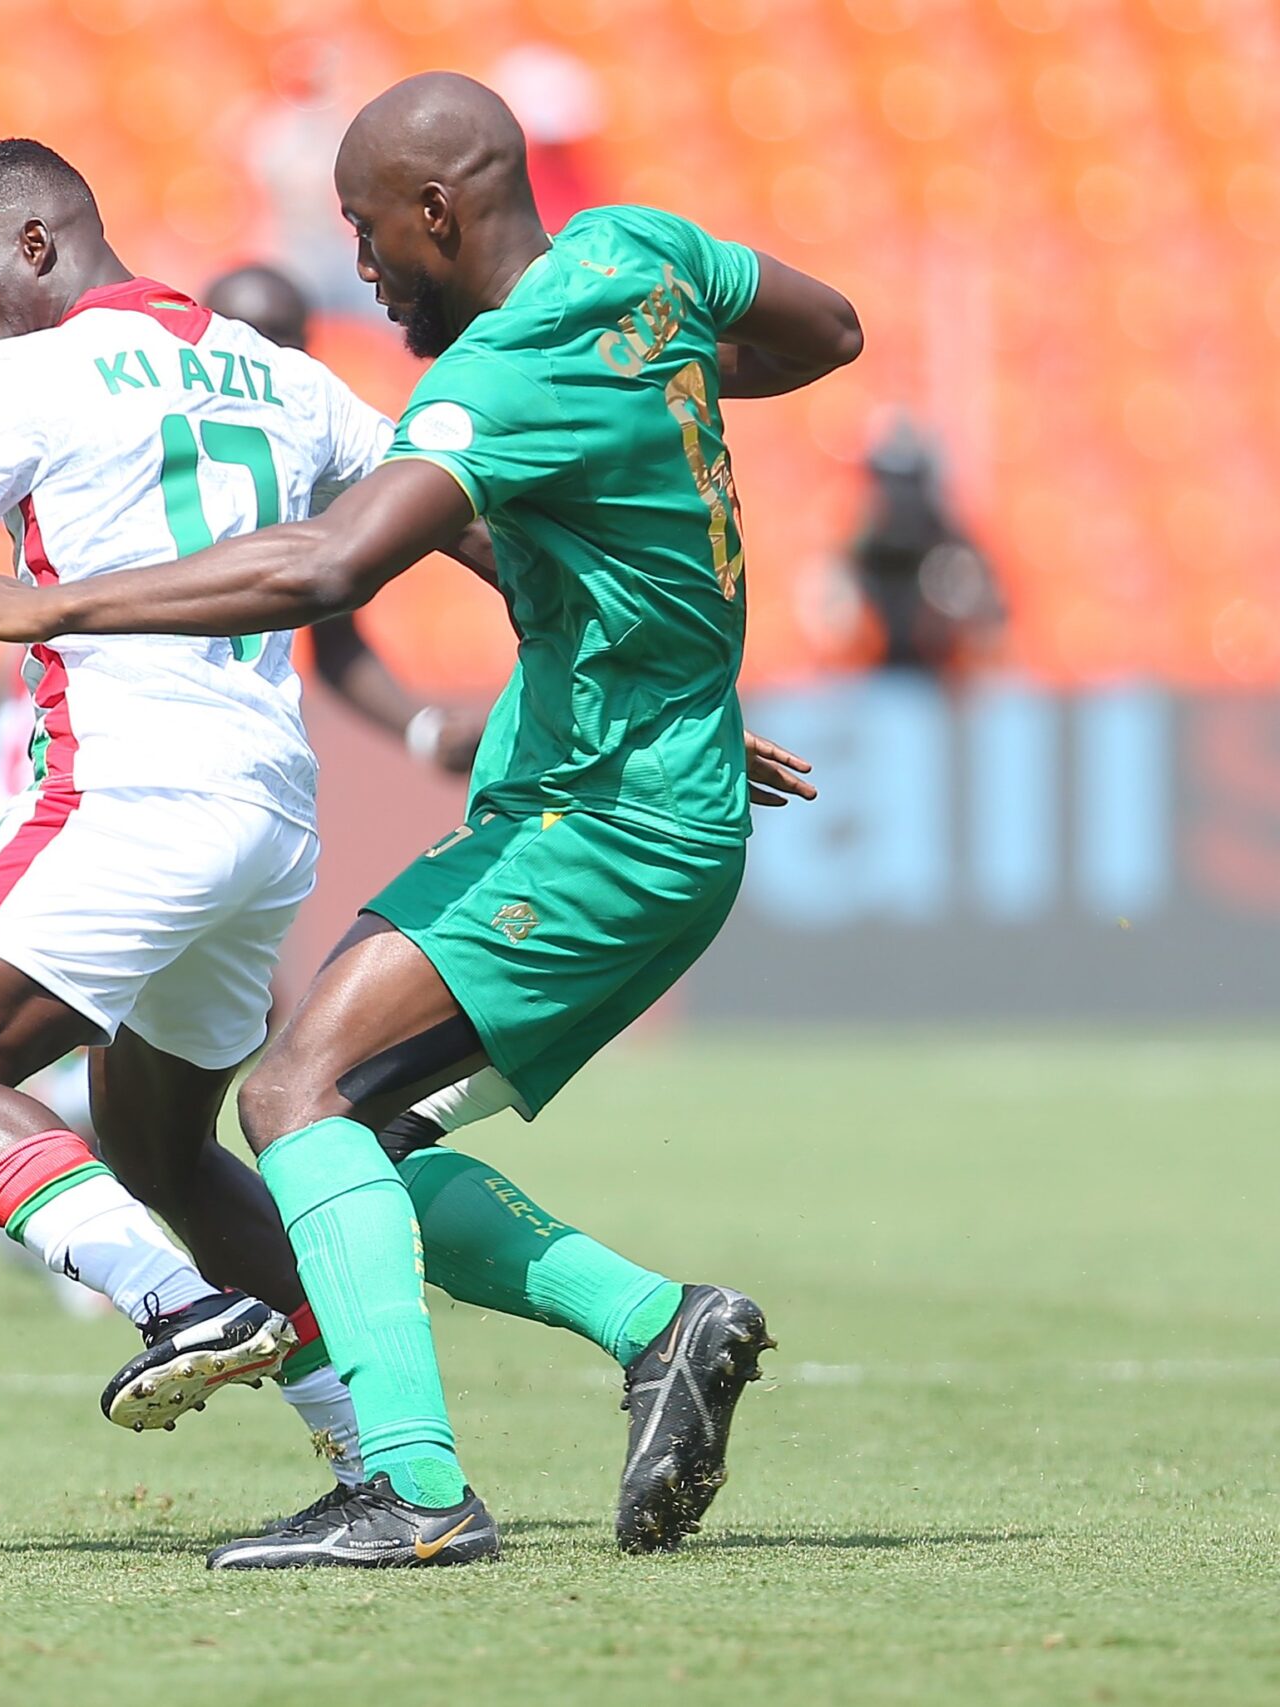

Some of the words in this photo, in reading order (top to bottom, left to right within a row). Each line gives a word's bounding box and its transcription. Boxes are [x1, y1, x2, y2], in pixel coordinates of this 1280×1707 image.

[94, 350, 161, 396] KI
[178, 348, 284, 407] AZIZ
[161, 414, 282, 662] 17
